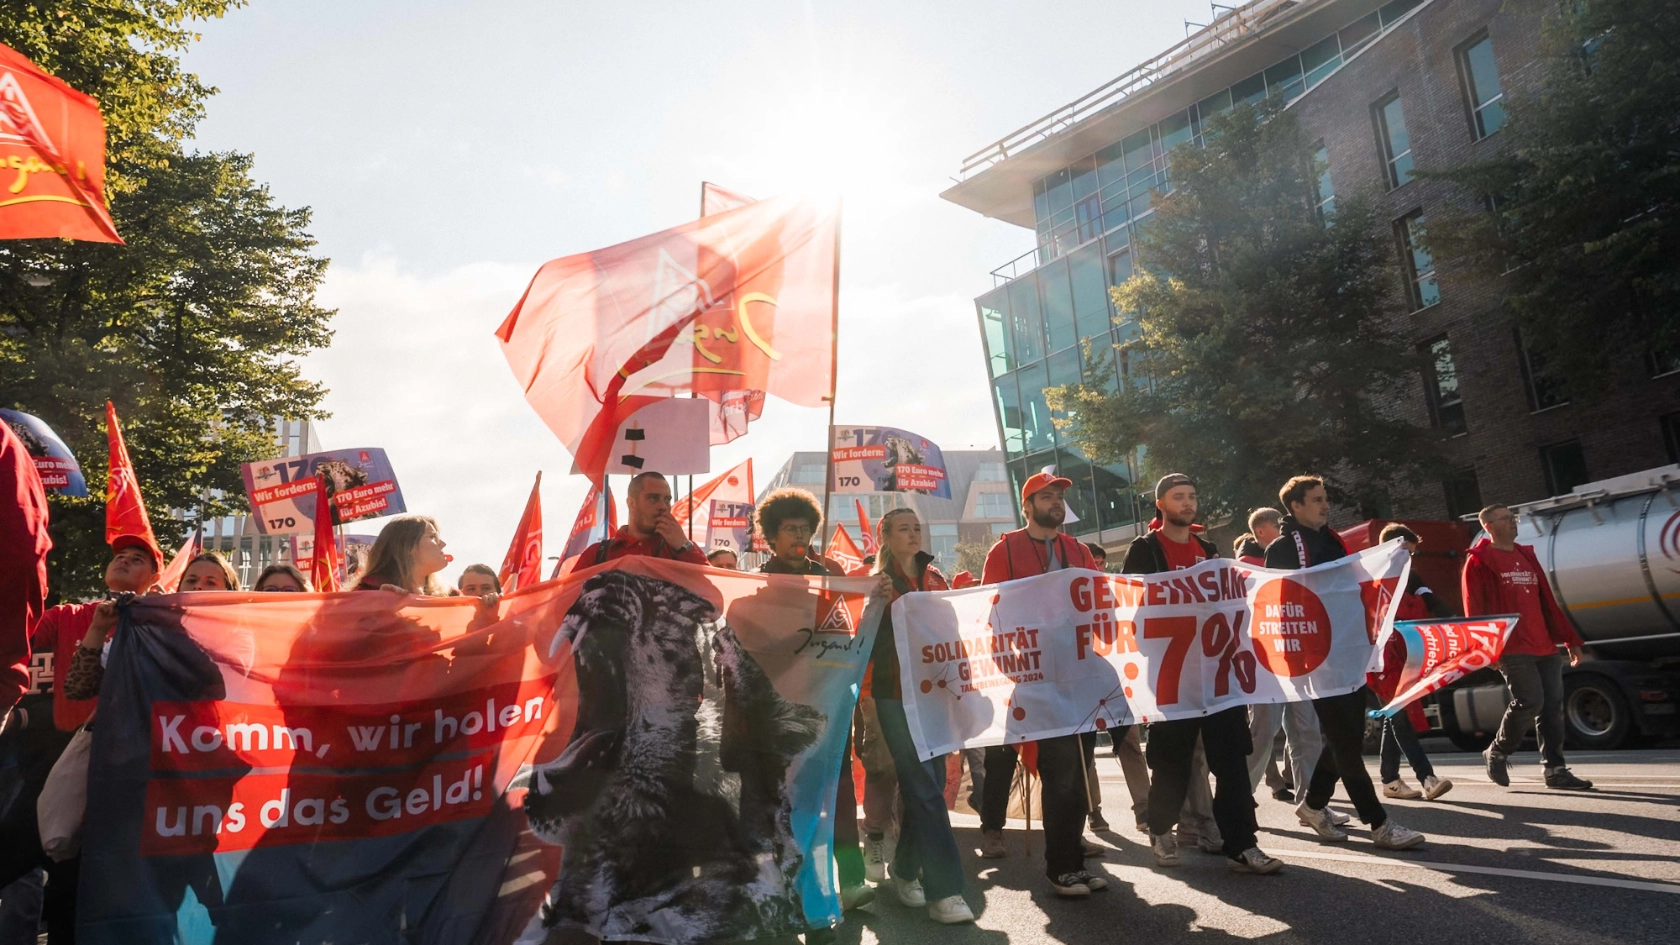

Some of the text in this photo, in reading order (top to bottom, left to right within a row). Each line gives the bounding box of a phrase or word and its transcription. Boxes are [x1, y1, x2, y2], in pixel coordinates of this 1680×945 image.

[833, 447, 884, 460] Wir fordern:
[898, 466, 910, 474] 170
[912, 467, 927, 475] Euro
[838, 476, 860, 487] 170
[254, 482, 317, 502] Wir fordern:
[336, 482, 394, 504] 170 Euro mehr
[340, 497, 387, 517] für Azubis!
[268, 517, 296, 529] 170
[714, 538, 730, 547] 170
[1070, 567, 1252, 612] GEMEINSAM
[1265, 601, 1305, 618] DAFÜR
[1259, 621, 1318, 635] STREITEN
[921, 626, 1039, 664] SOLIDARITÄT
[1273, 638, 1301, 652] WIR
[958, 650, 1042, 681] GEWINNT
[1075, 610, 1257, 706] FÜR 7%
[960, 672, 1044, 693] TARIFBEWEGUNG 2024
[159, 696, 543, 759] Komm, wir holen
[155, 764, 483, 837] uns das Geld!
